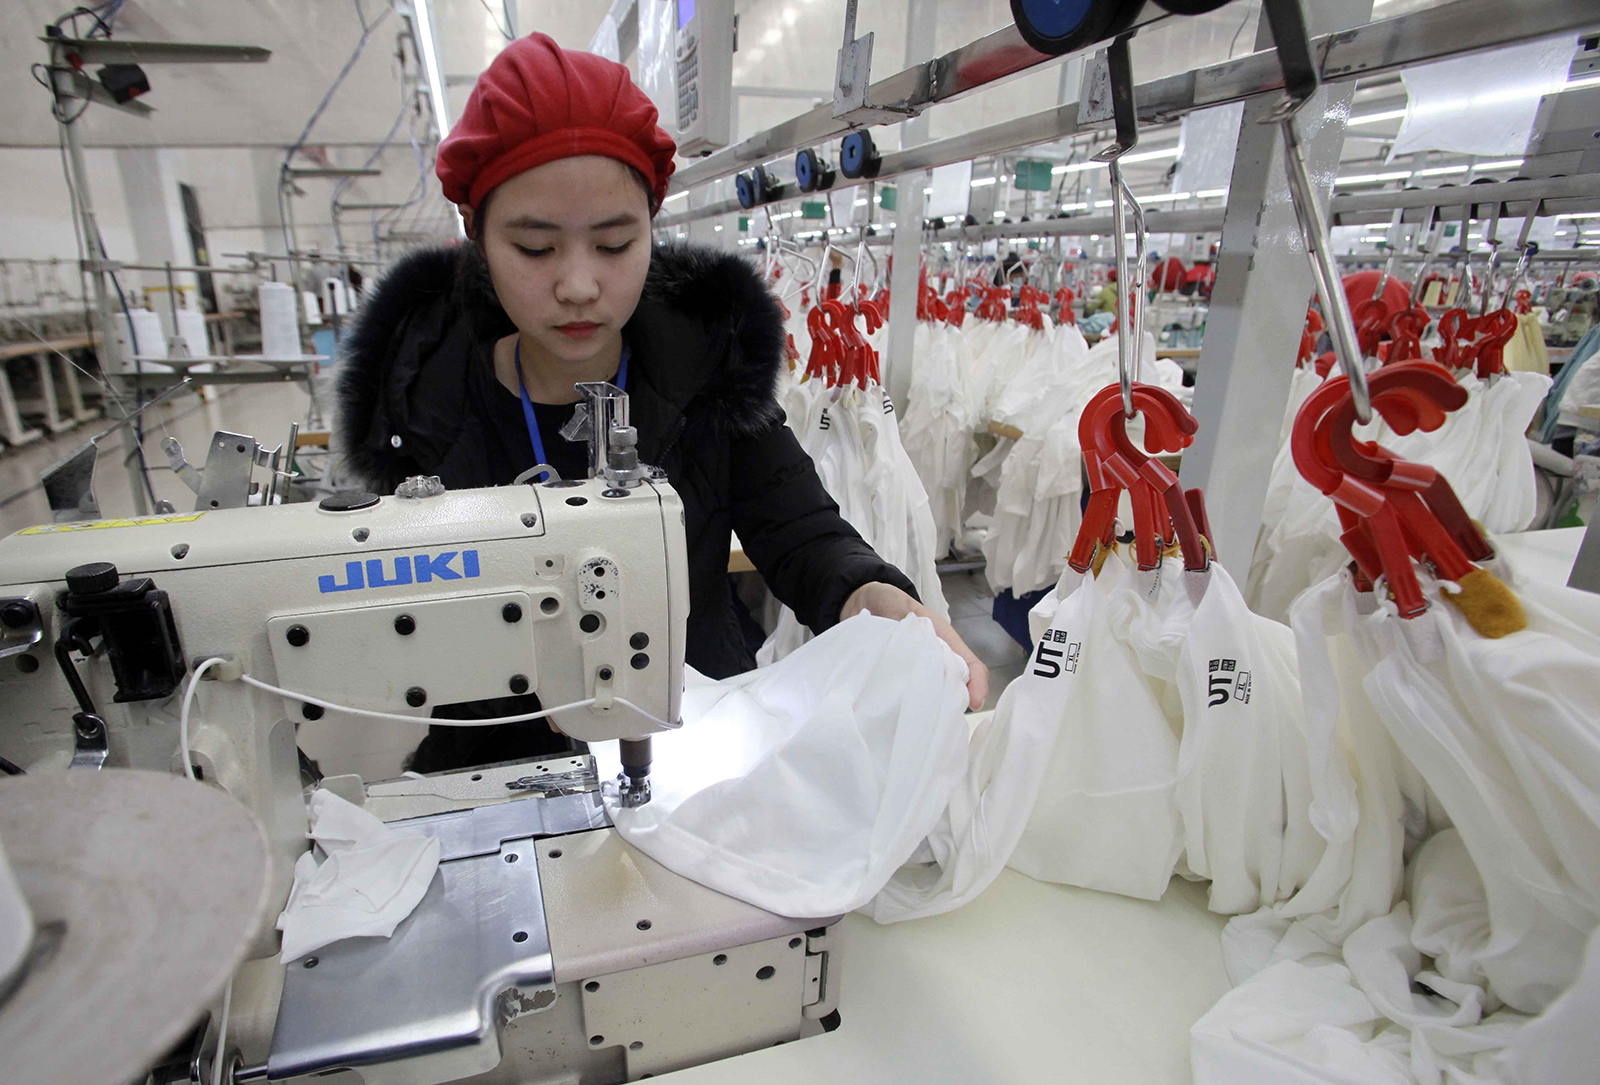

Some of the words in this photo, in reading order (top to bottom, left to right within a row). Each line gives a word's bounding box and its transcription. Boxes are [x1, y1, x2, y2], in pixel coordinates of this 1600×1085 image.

[318, 550, 481, 594] JUKI
[1033, 641, 1063, 678] UT
[1208, 674, 1232, 708] UT
[1237, 682, 1246, 691] XL
